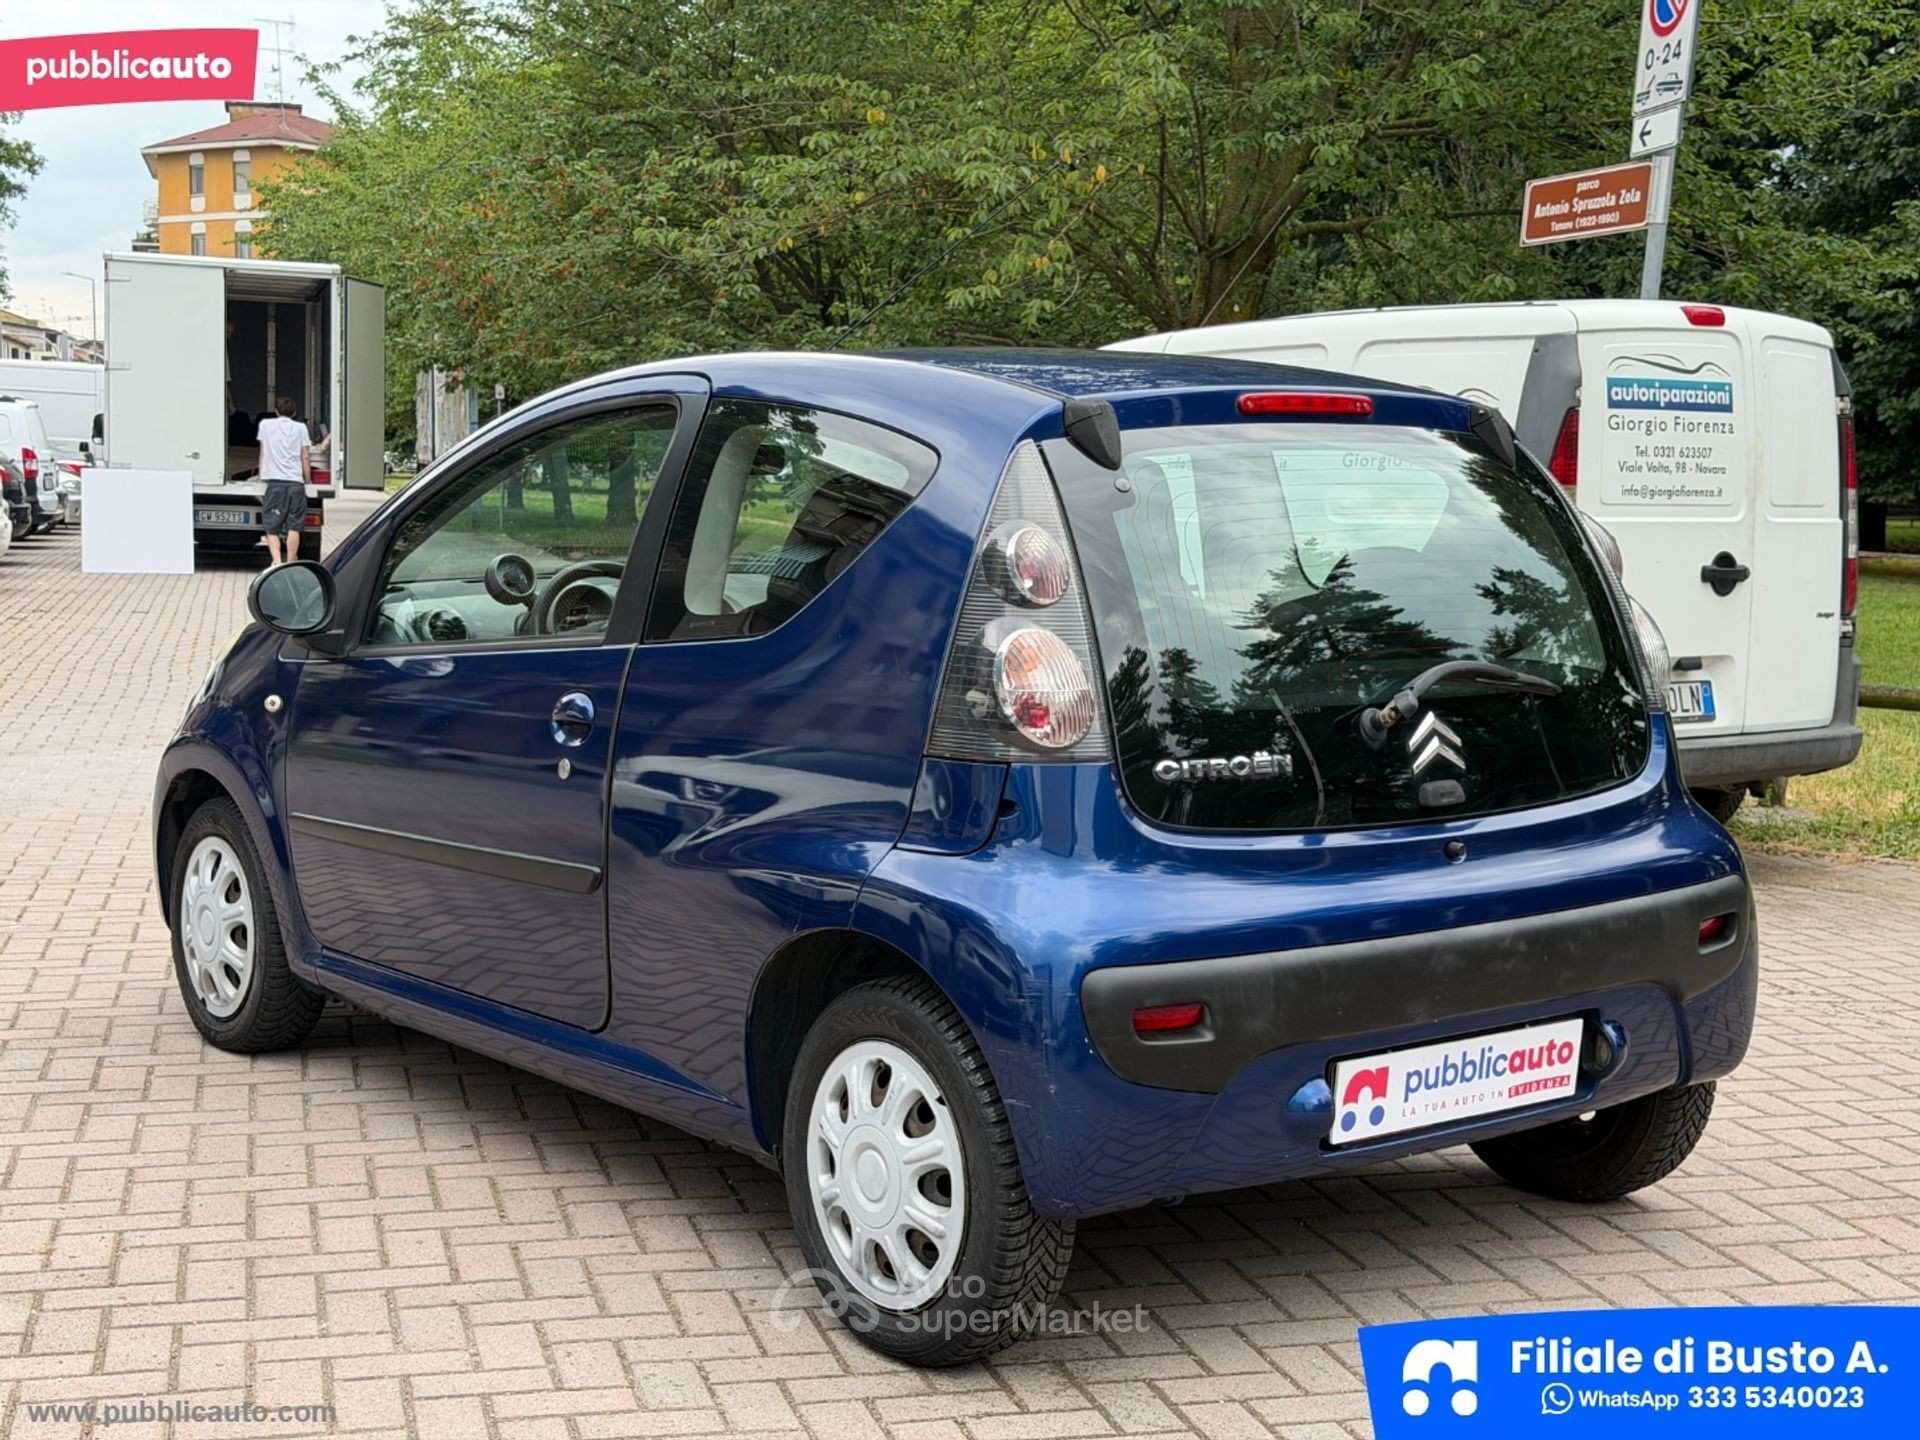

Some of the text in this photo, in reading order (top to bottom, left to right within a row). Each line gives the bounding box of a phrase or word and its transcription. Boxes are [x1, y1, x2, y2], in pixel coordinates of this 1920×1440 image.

[1576, 179, 1600, 193] parco
[1534, 188, 1641, 218] Antonio Spruzzola Zola
[1550, 220, 1573, 232] Tenore
[1610, 382, 1730, 407] autoriparazioni
[1607, 414, 1735, 436] Giorgio Fiorenza
[1342, 452, 1402, 472] Giorgio
[1635, 445, 1712, 459] Tel. 0321 623507
[1618, 460, 1643, 473] Viale
[1646, 461, 1672, 475] Volta,
[1675, 462, 1687, 473] 98
[1695, 462, 1726, 474] Novara
[1621, 484, 1723, 500] info@giorgiofiorenza.it
[1153, 751, 1293, 781] CITROËN
[1403, 1040, 1574, 1103] pubblicauto
[1402, 1076, 1571, 1118] LA TUA AUTO IN EVIDENZA
